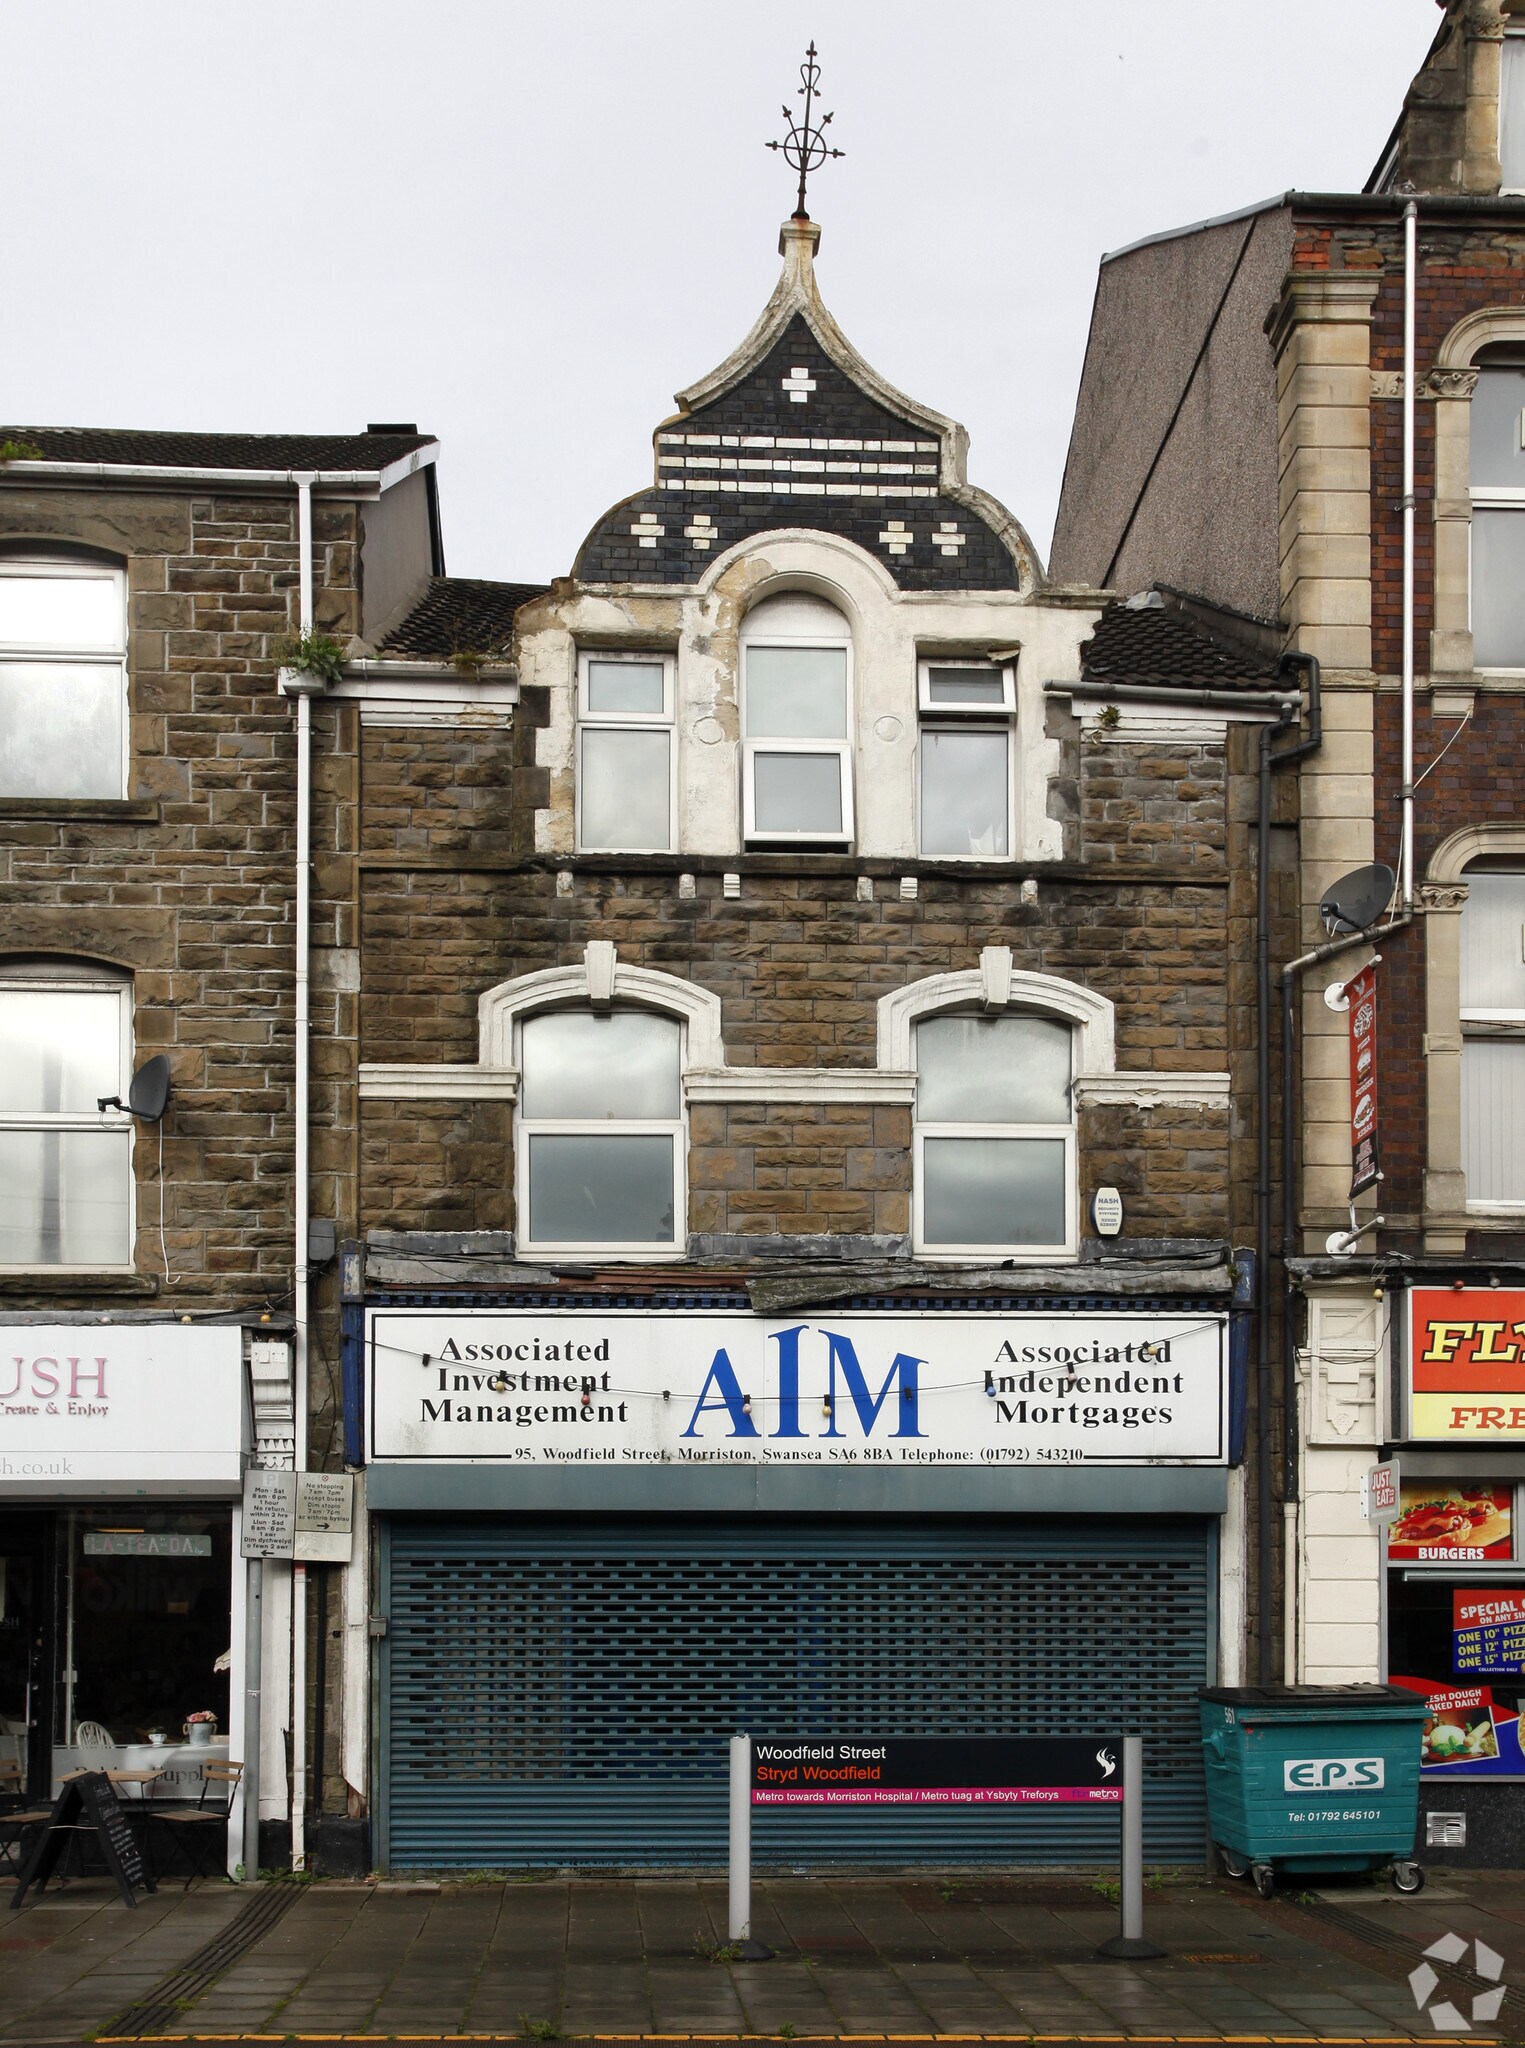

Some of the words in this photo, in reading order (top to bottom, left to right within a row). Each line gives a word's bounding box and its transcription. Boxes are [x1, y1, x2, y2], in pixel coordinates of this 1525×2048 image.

[439, 1337, 610, 1362] Associated
[1421, 1320, 1525, 1363] FL
[994, 1340, 1172, 1364] Associated
[437, 1368, 611, 1393] Investment
[679, 1325, 930, 1438] AIM
[984, 1370, 1184, 1398] Independent
[45, 1402, 59, 1415] &
[68, 1402, 109, 1417] Enjoy
[420, 1399, 628, 1428] Management
[995, 1400, 1173, 1428] Mortgages
[515, 1448, 536, 1461] 95,
[543, 1447, 617, 1460] Woodfield
[622, 1447, 672, 1462] Street,
[678, 1447, 757, 1462] Morriston,
[763, 1448, 822, 1460] Swansea
[828, 1448, 858, 1460] SA6
[863, 1448, 893, 1460] 8BA
[899, 1447, 974, 1463] Telephone:
[979, 1447, 1030, 1463] (01792)
[1036, 1447, 1083, 1461] 543210
[266, 1474, 277, 1485] P
[1372, 1470, 1391, 1491] JUST
[1376, 1488, 1390, 1507] EAT
[1418, 1547, 1485, 1560] BURGERS
[1460, 1600, 1518, 1620] SPECIAL
[1480, 1616, 1492, 1624] ON
[1495, 1613, 1512, 1622] ANY
[1458, 1631, 1481, 1643] ONE
[1458, 1644, 1482, 1656] ONE
[1458, 1656, 1482, 1668] ONE
[1448, 1689, 1482, 1700] DOUGH
[1455, 1698, 1480, 1708] DAILY
[756, 1745, 834, 1760] Woodfield
[839, 1745, 887, 1760] Street
[757, 1767, 798, 1783] Stryd
[803, 1766, 881, 1781] Woodfield
[756, 1792, 783, 1801] Metro
[785, 1792, 825, 1801] towards
[827, 1791, 872, 1801] Morriston
[874, 1791, 913, 1803] Hospital
[921, 1791, 949, 1801] Metro
[950, 1791, 973, 1803] tuag
[975, 1791, 985, 1801] at
[986, 1790, 1019, 1802] Ysbyty
[1021, 1790, 1059, 1802] Treforys
[1288, 1813, 1305, 1822] Tel:
[1307, 1812, 1340, 1821] 01792
[1342, 1810, 1381, 1820] 645101
